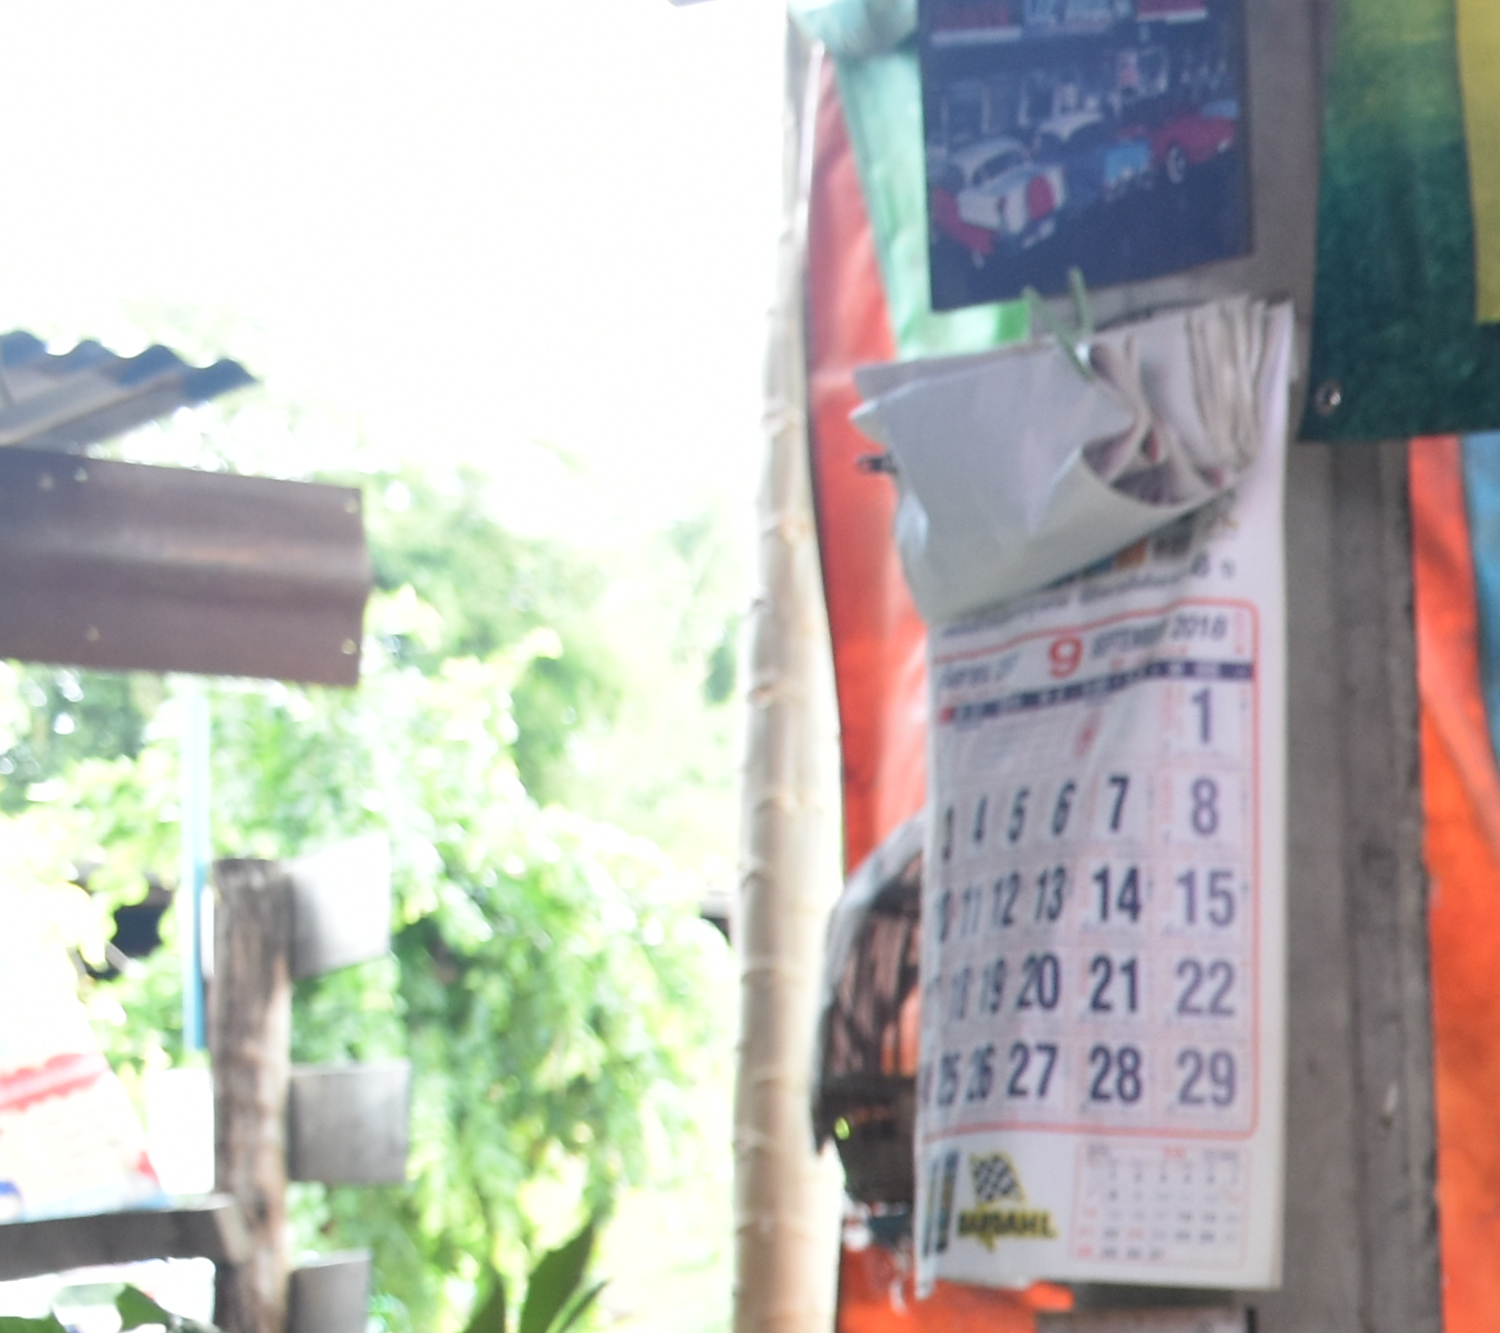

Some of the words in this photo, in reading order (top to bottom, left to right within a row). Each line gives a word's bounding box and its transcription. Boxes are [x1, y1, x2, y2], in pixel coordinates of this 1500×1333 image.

[1048, 636, 1083, 678] 9
[1191, 687, 1211, 744] 1
[1007, 786, 1031, 844] 5
[1052, 778, 1077, 836] 6
[1108, 773, 1131, 834] 7
[1190, 778, 1220, 836] 8
[993, 872, 1021, 927] 12
[1034, 866, 1067, 922] 13
[1092, 865, 1142, 923] 14
[1177, 869, 1236, 927] 15
[1015, 953, 1062, 1012] 20
[1089, 955, 1139, 1013] 21
[1175, 958, 1236, 1018] 22
[1007, 1041, 1059, 1099] 27
[1089, 1044, 1143, 1102] 28
[1176, 1047, 1238, 1107] 29
